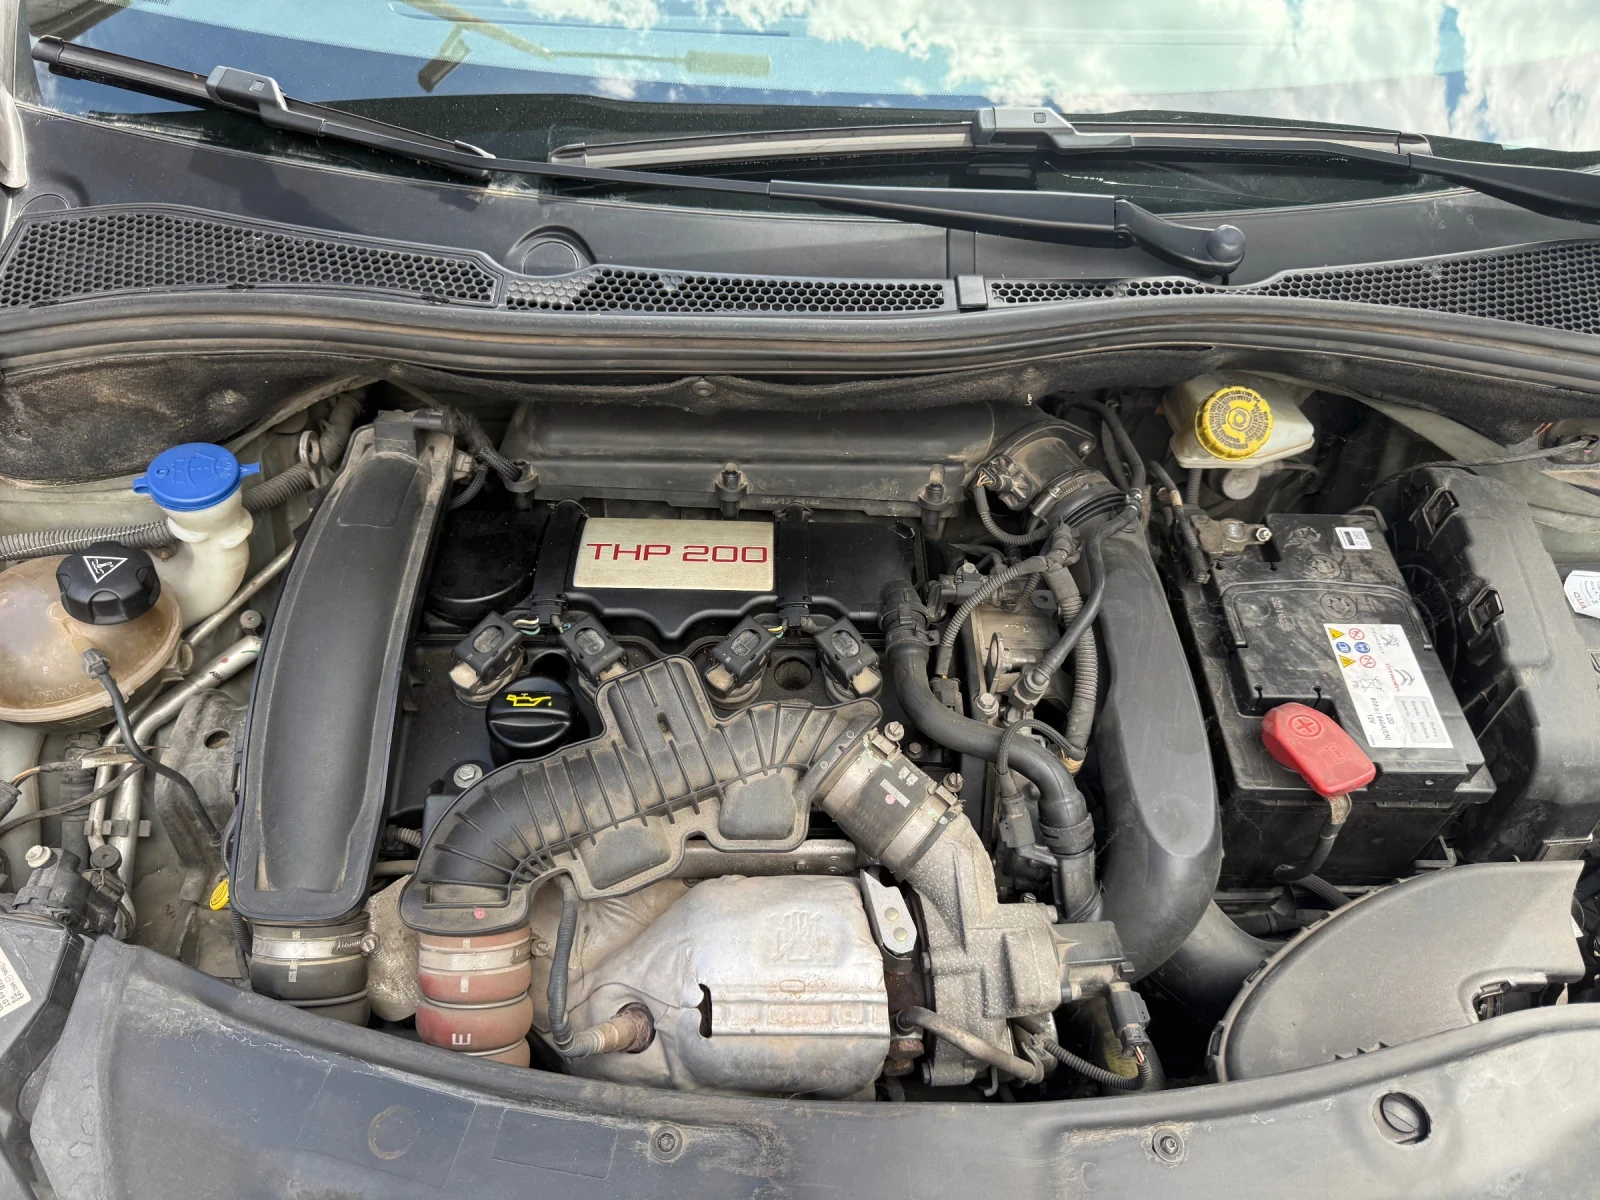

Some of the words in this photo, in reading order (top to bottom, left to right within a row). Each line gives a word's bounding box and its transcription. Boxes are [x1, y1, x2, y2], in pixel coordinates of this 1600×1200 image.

[586, 543, 671, 561] THP
[682, 545, 768, 563] 200
[38, 682, 87, 704] MAX
[1366, 714, 1376, 723] 12V
